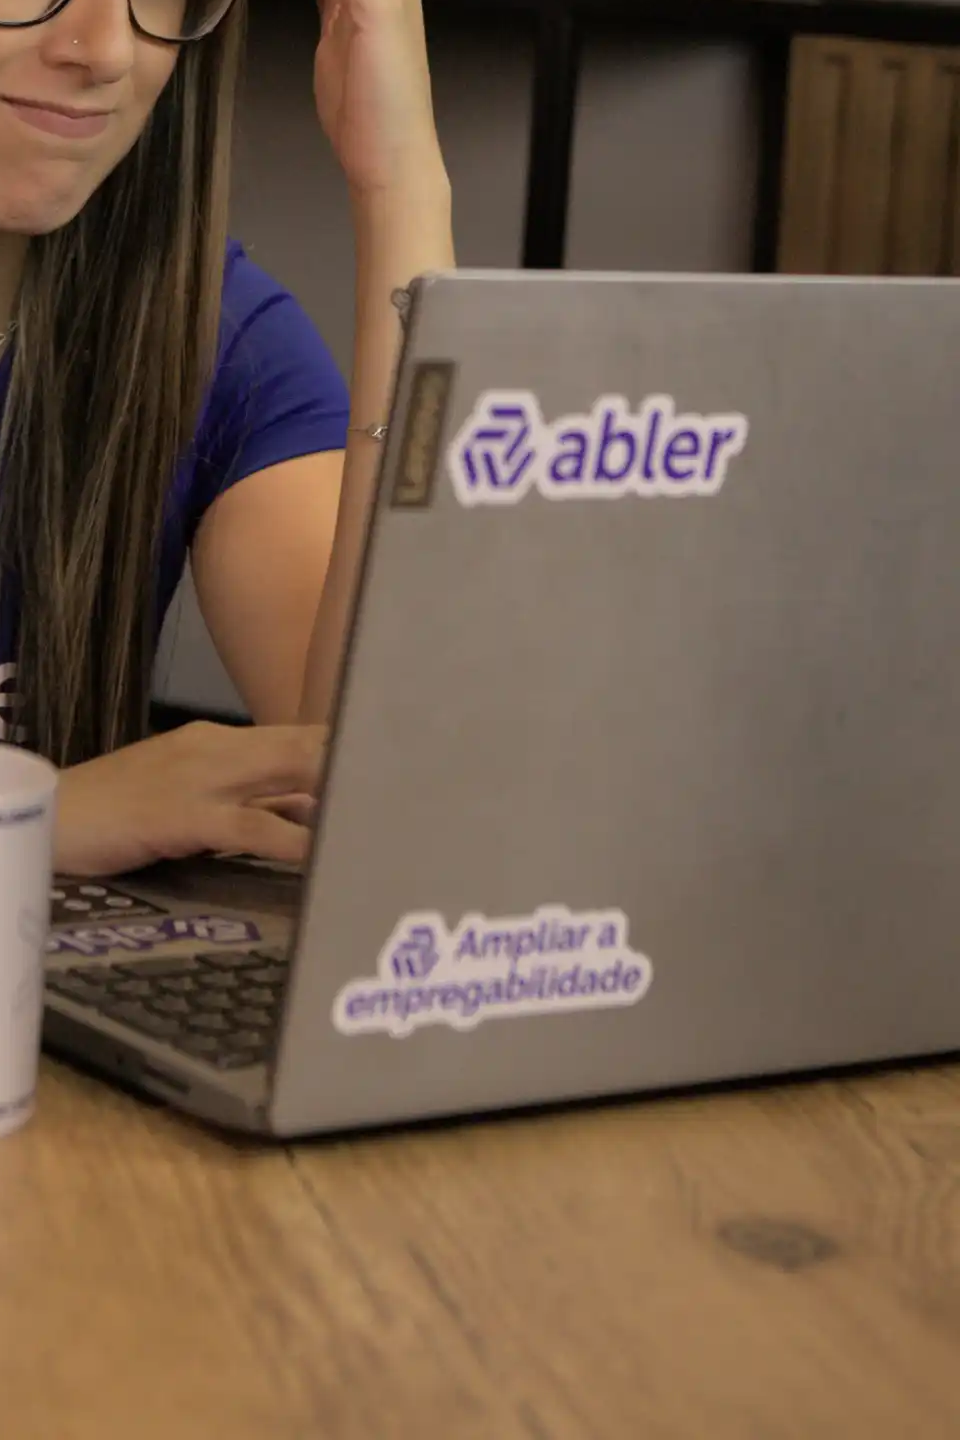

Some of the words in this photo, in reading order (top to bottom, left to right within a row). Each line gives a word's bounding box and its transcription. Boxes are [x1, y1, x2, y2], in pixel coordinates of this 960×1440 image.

[549, 411, 735, 483] abler
[456, 920, 591, 964] Ampliar
[597, 923, 617, 948] a
[346, 960, 642, 1021] empregabilidade
